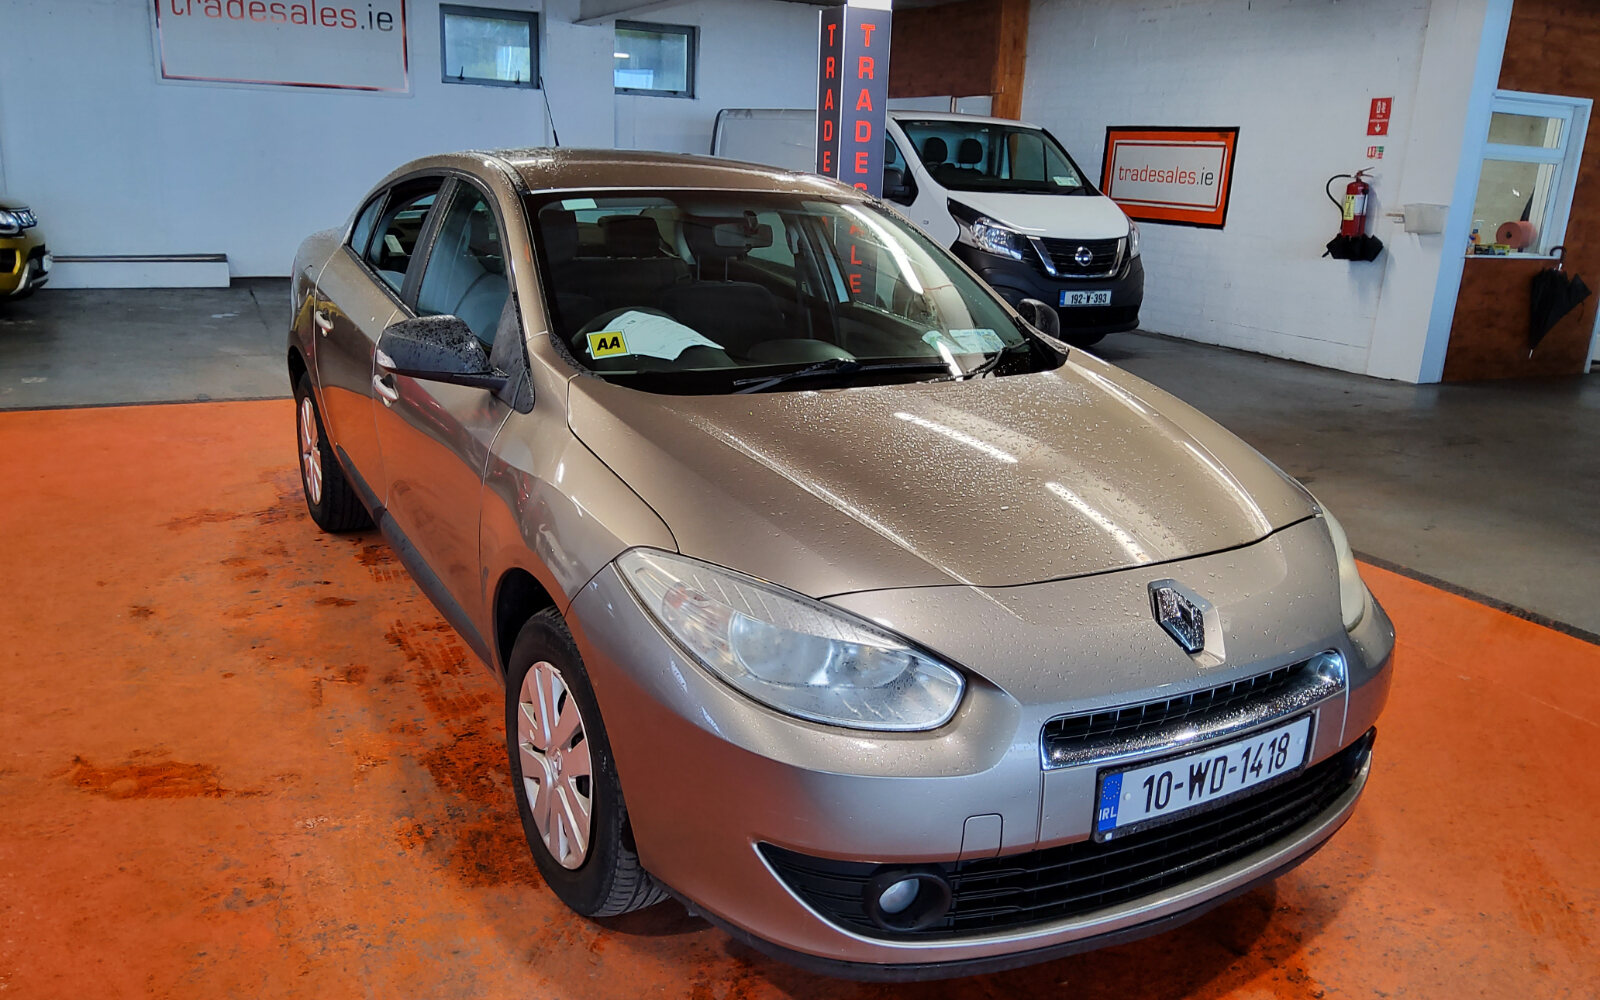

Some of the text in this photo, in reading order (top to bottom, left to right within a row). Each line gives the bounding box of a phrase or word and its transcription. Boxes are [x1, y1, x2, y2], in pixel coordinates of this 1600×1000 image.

[171, 0, 393, 32] tradesales.ie
[1118, 164, 1214, 186] tradesales.ie
[597, 336, 621, 351] AA
[1143, 732, 1291, 814] 10-WD-1418
[1098, 808, 1117, 821] IRL
